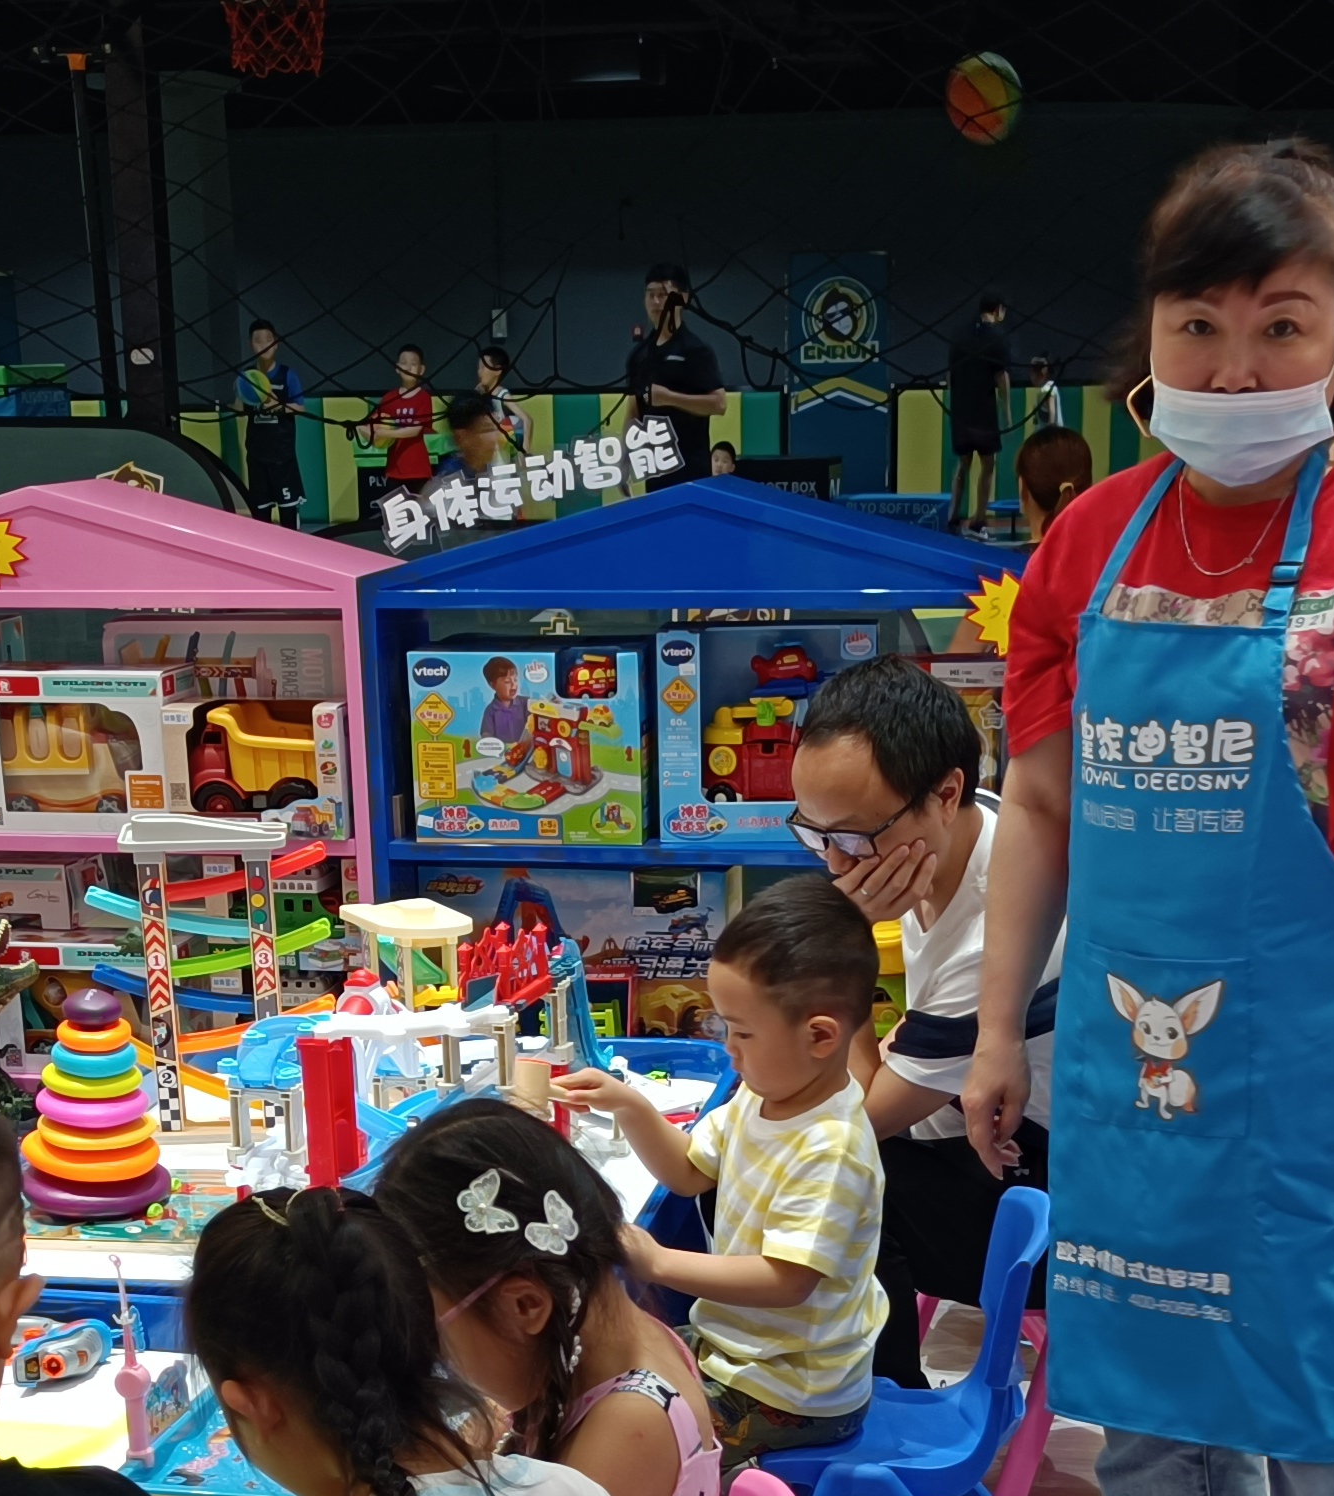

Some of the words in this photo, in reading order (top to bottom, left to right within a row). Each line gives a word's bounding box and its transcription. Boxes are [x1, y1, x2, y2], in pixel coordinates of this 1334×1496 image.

[382, 419, 679, 549] 身体运动智能
[879, 503, 908, 515] SOFT
[280, 648, 298, 669] CAR
[663, 647, 693, 657] vtech
[414, 666, 449, 677] vtech
[1081, 714, 1254, 765] 皇家迪智尼
[1134, 772, 1250, 791] DEEDSNY
[1152, 807, 1244, 833] 让智传递
[152, 955, 161, 967] 1
[260, 952, 269, 965] 3
[162, 1072, 171, 1085] 2
